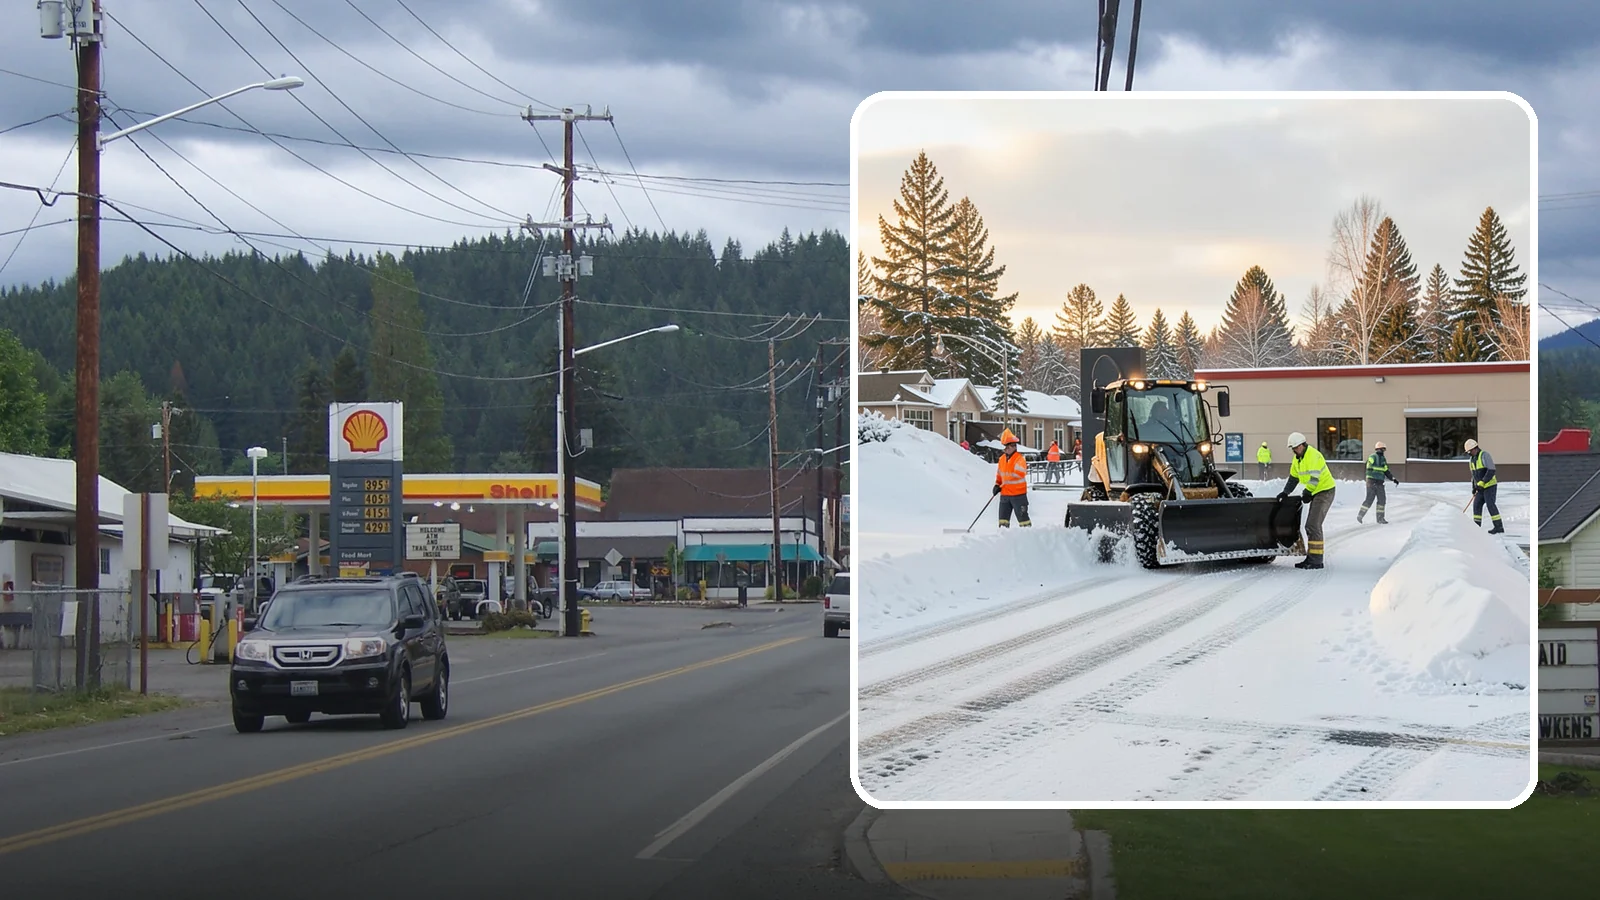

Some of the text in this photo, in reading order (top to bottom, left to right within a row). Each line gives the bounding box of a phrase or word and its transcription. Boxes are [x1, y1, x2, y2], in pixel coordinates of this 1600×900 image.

[365, 480, 384, 490] 395
[490, 484, 547, 499] Shell
[365, 494, 384, 504] 405
[365, 508, 384, 518] 415
[365, 522, 384, 532] 429
